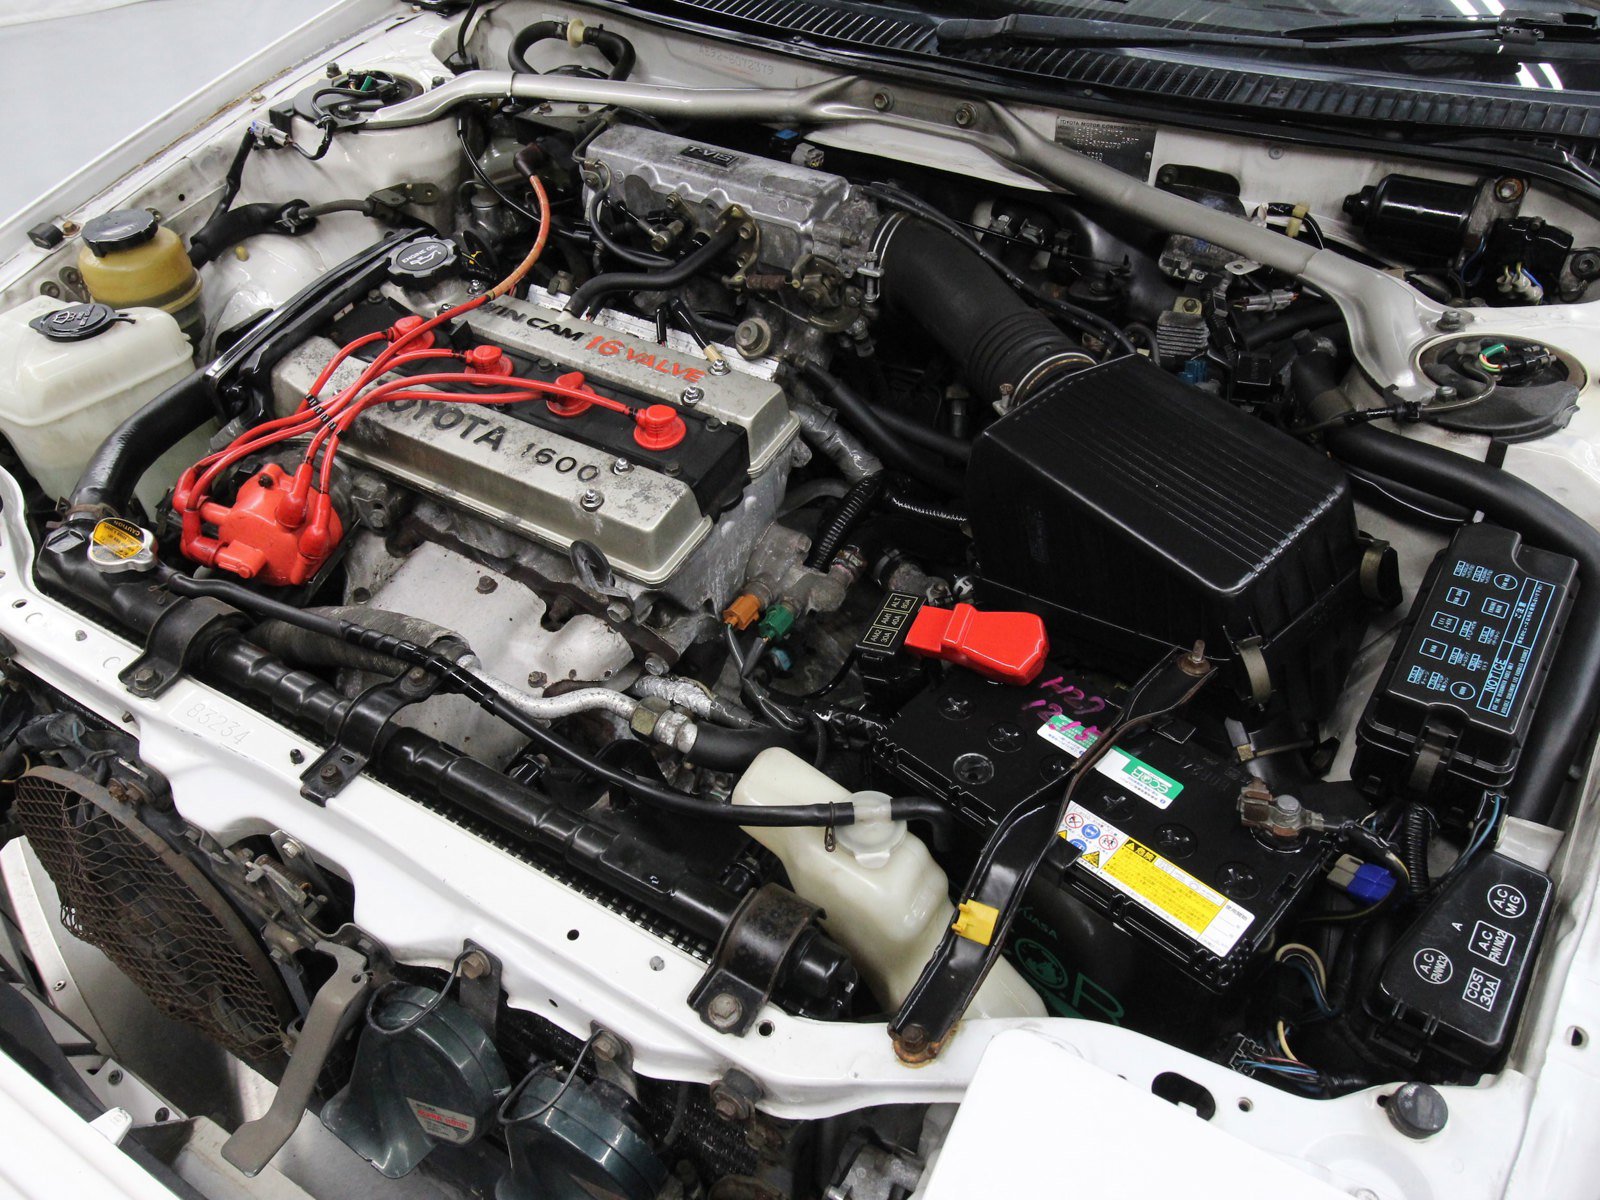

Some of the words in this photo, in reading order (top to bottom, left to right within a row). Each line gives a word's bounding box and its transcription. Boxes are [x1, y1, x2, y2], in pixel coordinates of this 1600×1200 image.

[401, 249, 427, 263] ENGINE
[527, 317, 585, 342] CAM
[585, 335, 625, 357] 16
[626, 347, 706, 383] VALVE
[386, 399, 507, 452] OYOTA
[520, 442, 602, 483] 1600
[113, 520, 141, 536] CAUTION
[891, 597, 901, 608] ALT
[881, 613, 891, 624] AM1
[892, 616, 902, 626] 40A
[870, 630, 882, 641] AM2
[881, 632, 891, 643] 30A
[1485, 657, 1506, 692] NOTICE
[1135, 846, 1156, 863] 危険
[1452, 922, 1463, 932] A
[1466, 973, 1484, 999] CDS
[1480, 980, 1498, 1006] 30A
